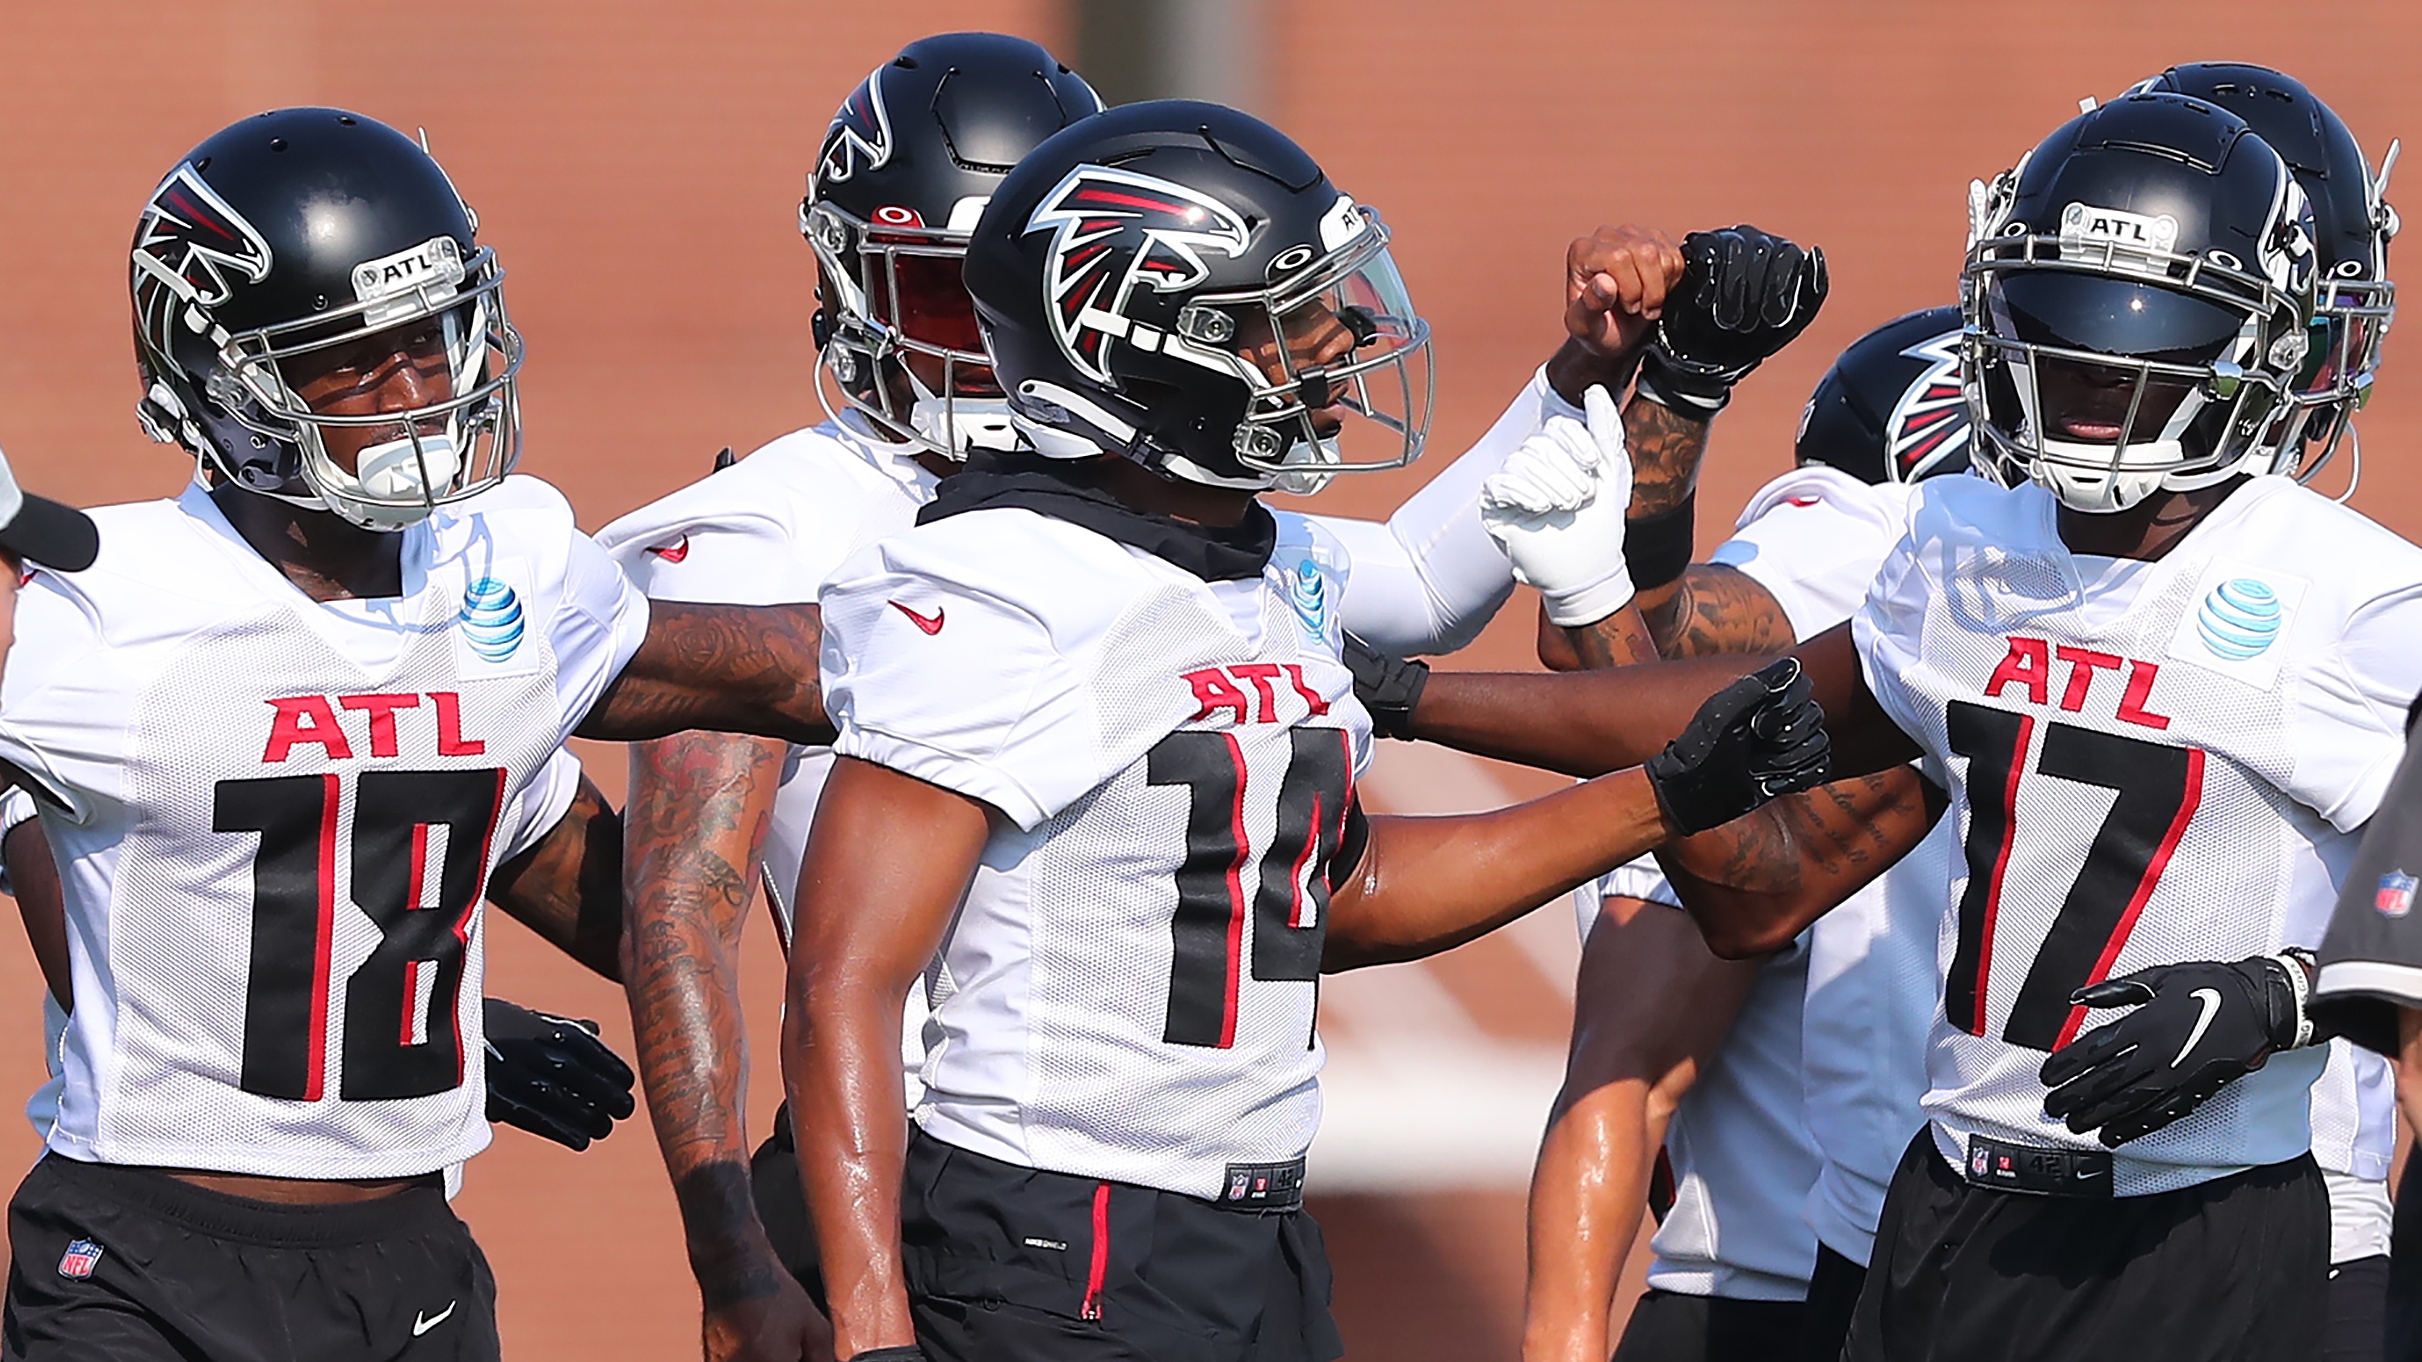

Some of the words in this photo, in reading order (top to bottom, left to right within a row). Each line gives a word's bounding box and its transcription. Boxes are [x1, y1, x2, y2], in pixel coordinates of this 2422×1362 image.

[2090, 218, 2146, 241] ATL
[383, 255, 432, 283] ATL
[1181, 664, 1329, 724] ATL
[1984, 636, 2170, 730] ATL
[262, 692, 485, 763] ATL
[1147, 726, 1358, 1050] 14
[1946, 699, 2205, 1054] 17
[212, 767, 507, 1101] 18
[62, 1255, 90, 1275] NFL
